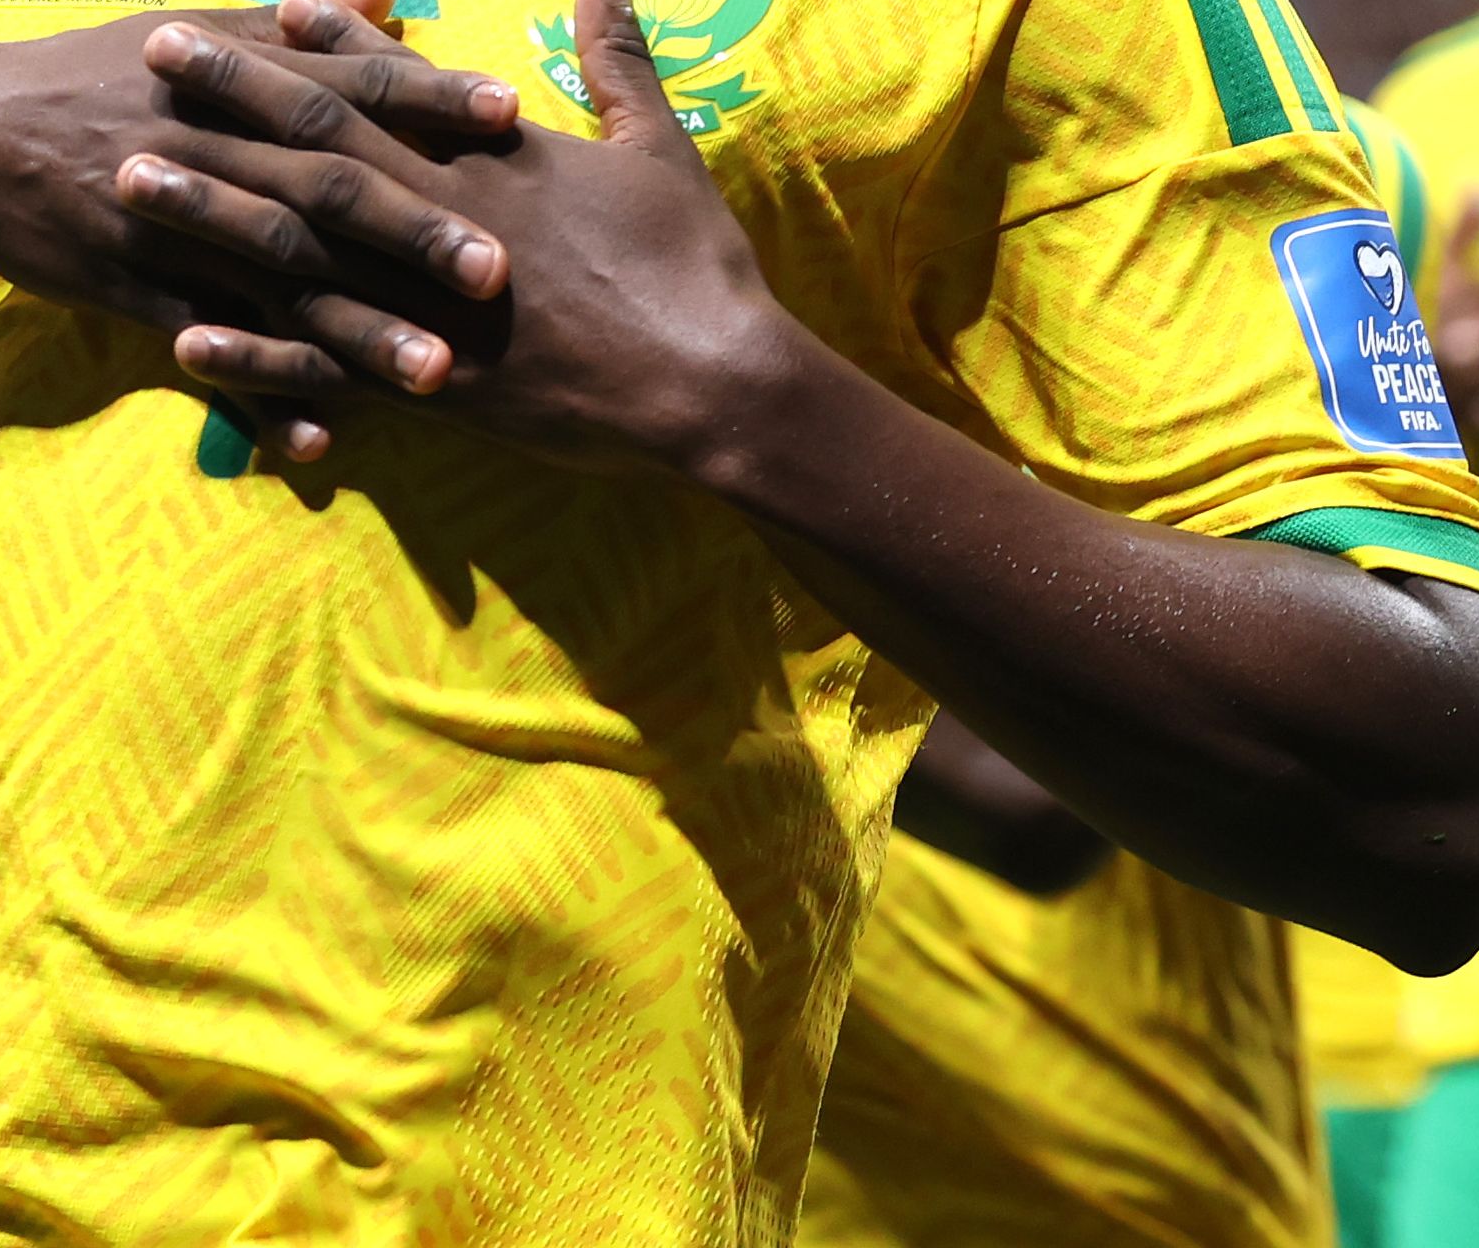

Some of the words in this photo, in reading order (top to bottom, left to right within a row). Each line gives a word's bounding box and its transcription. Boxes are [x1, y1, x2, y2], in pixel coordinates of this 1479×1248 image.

[550, 62, 594, 108] SOU
[1357, 315, 1411, 363] Unite
[1407, 319, 1433, 361] Fo
[1371, 363, 1447, 404] PEACE
[1399, 410, 1440, 431] FIFA
